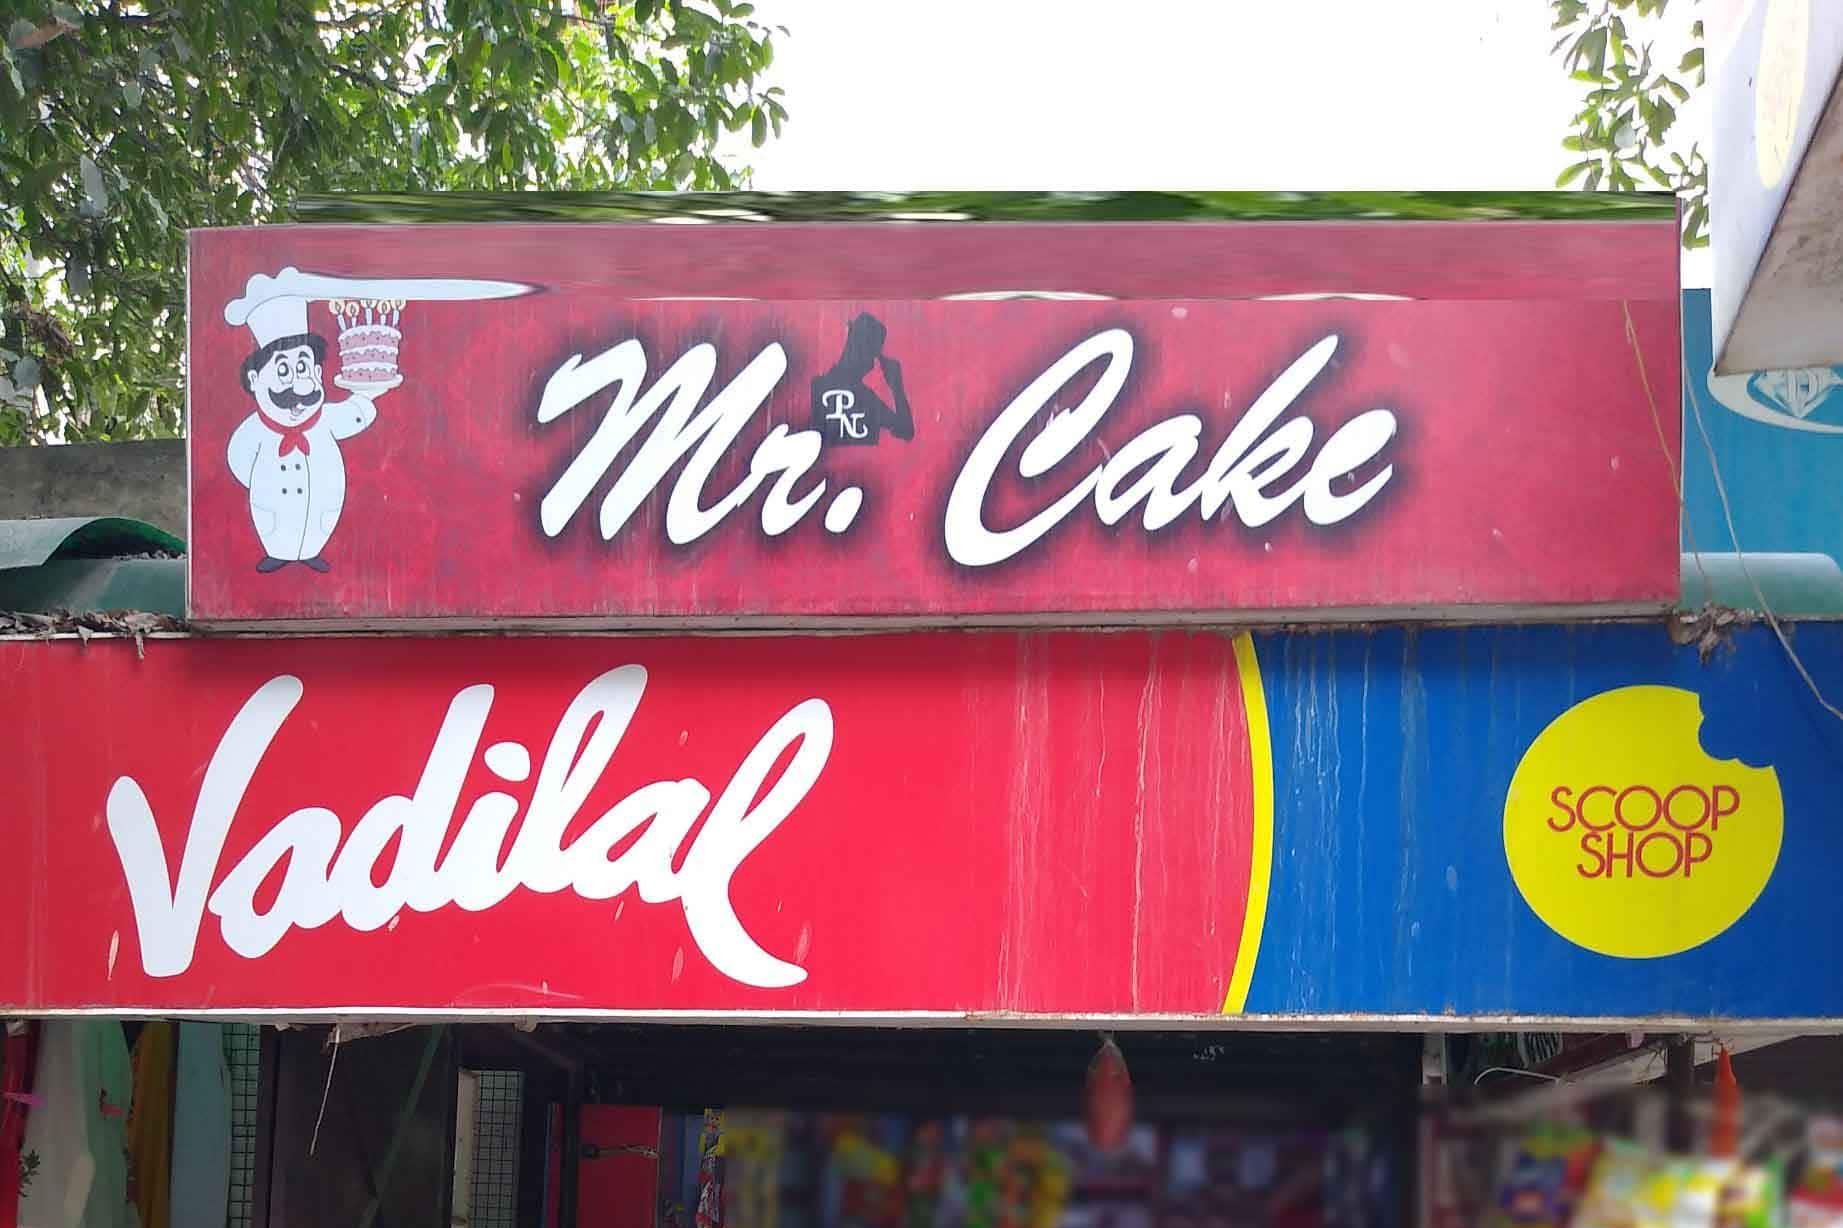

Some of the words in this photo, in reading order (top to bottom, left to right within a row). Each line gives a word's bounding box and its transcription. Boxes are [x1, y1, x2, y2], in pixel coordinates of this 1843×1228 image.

[537, 338, 863, 546] Mr.
[943, 328, 1398, 567] Cake
[106, 663, 835, 988] Vadilal
[1547, 785, 1740, 832] SCOOP
[1577, 832, 1713, 878] SHOP
